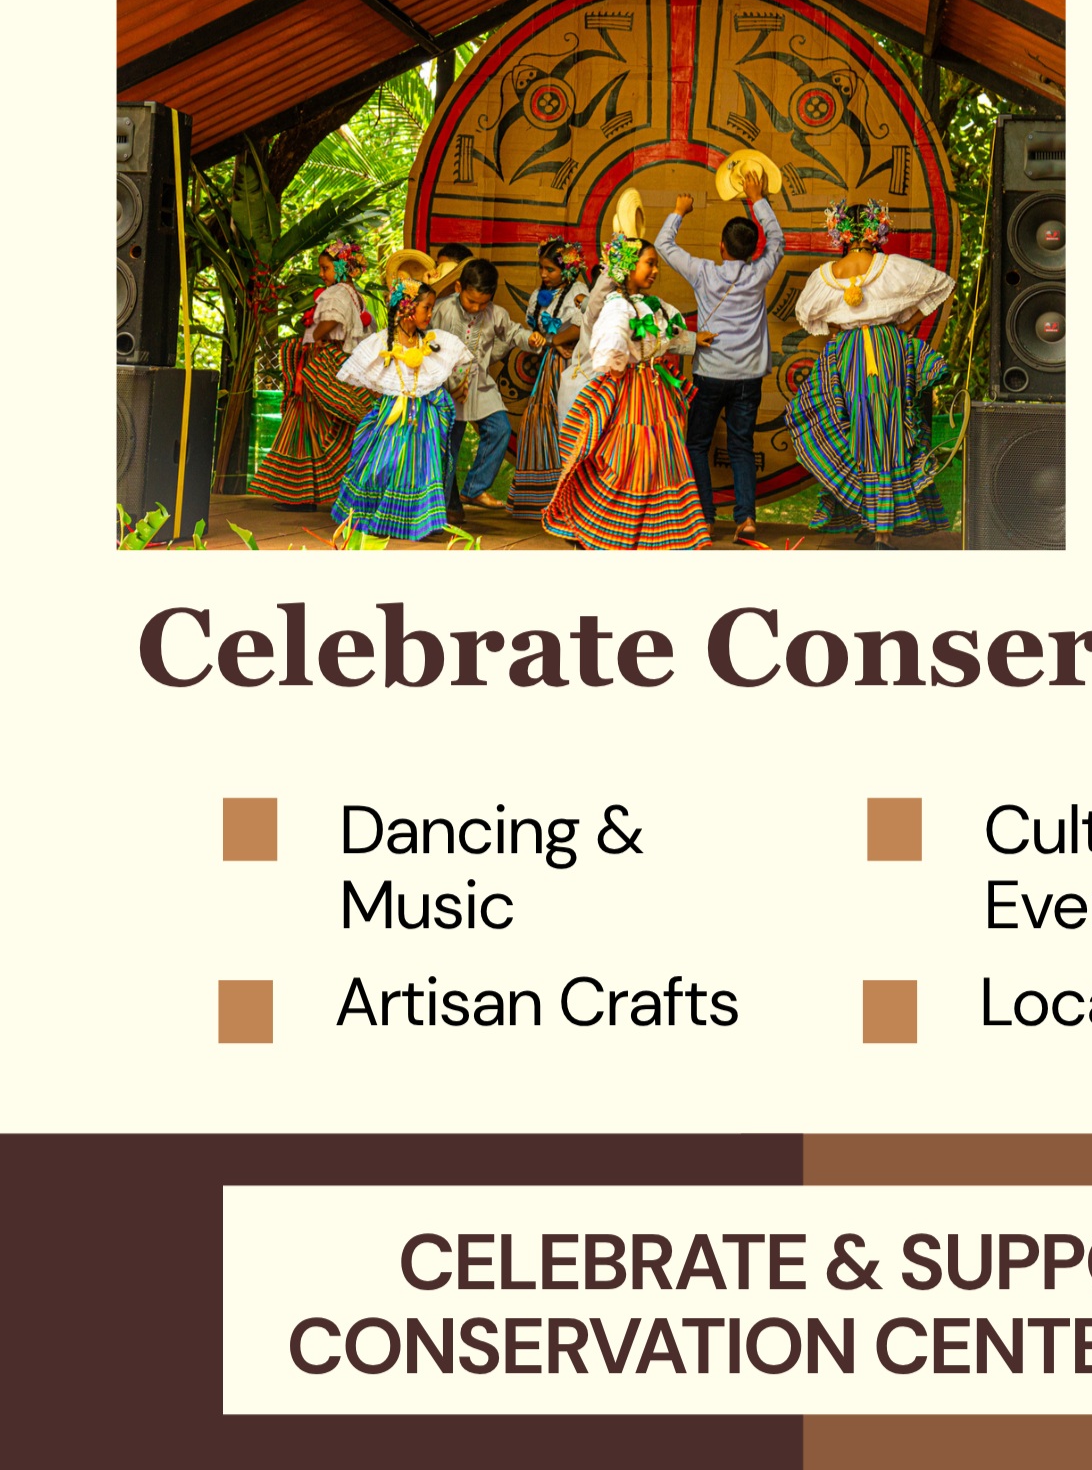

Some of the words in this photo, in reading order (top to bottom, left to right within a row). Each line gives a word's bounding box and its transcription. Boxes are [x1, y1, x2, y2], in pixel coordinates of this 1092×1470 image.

[140, 602, 674, 688] Celebrate
[343, 804, 580, 870] Dancing
[597, 804, 644, 855] &
[343, 879, 513, 930] Music
[336, 976, 541, 1027] Artisan
[561, 976, 738, 1027] Crafts
[401, 1233, 806, 1291] CELEBRATE
[826, 1233, 883, 1290] &
[290, 1317, 854, 1375] CONSERVATION
